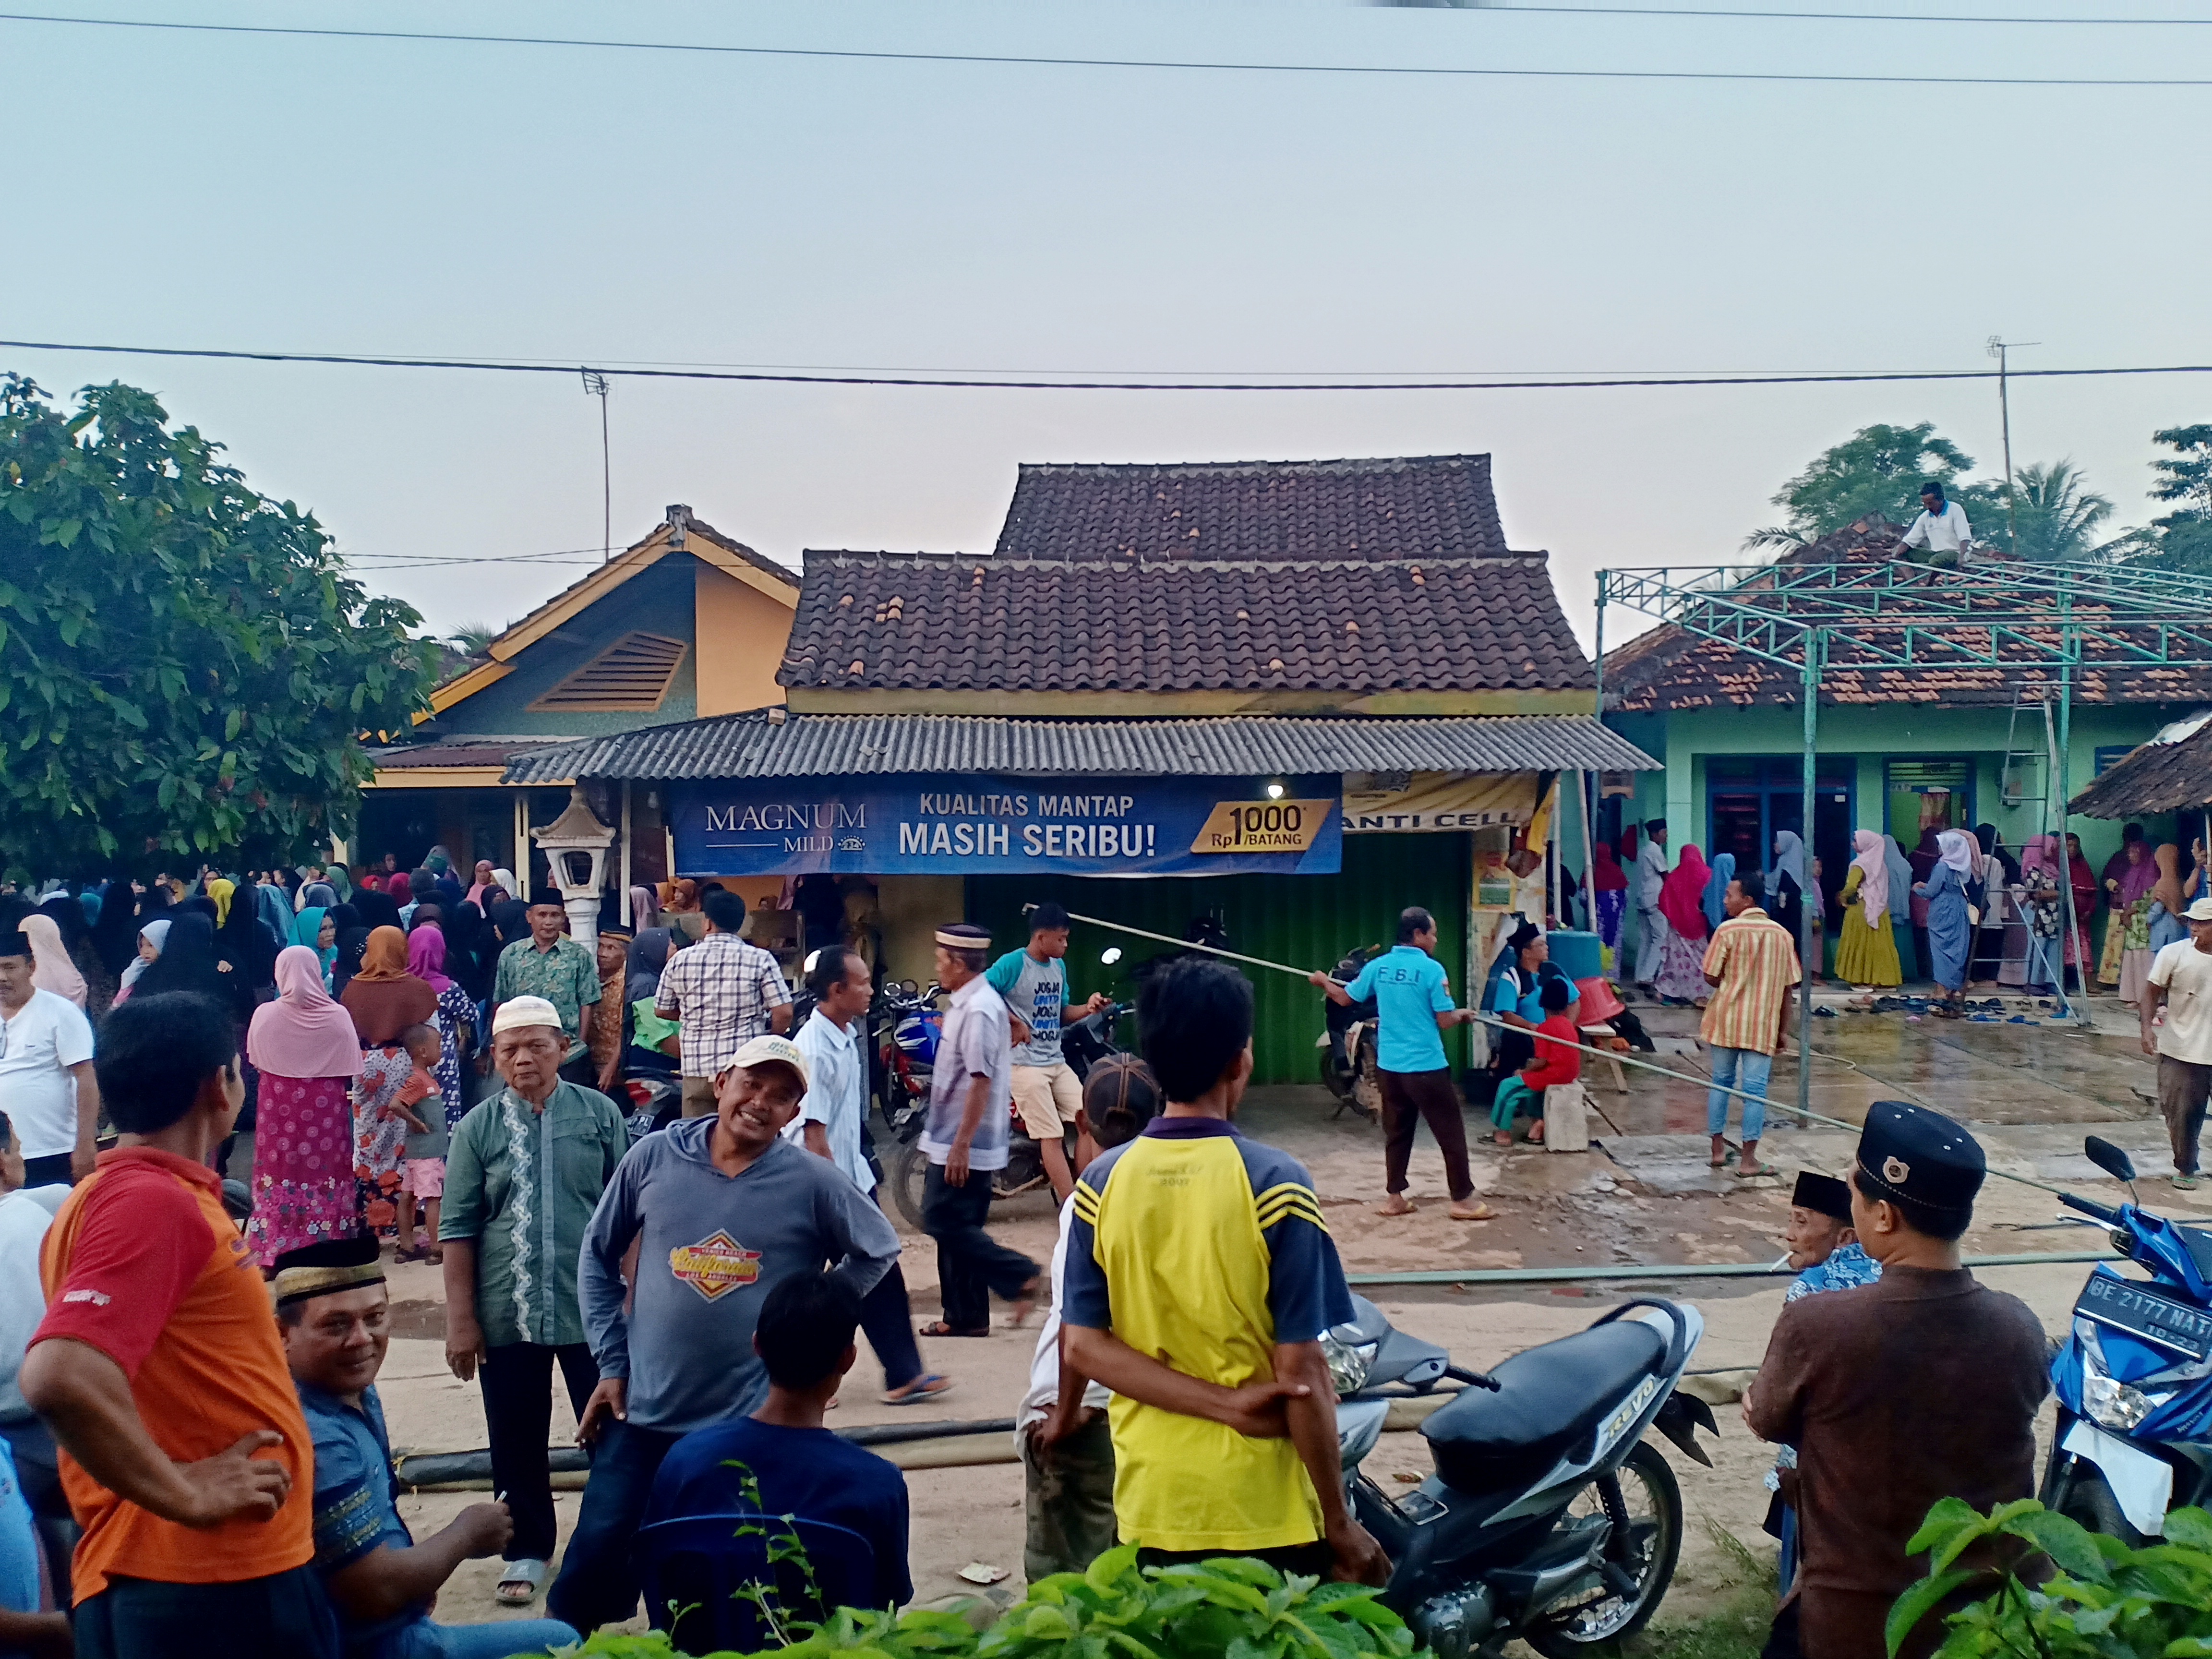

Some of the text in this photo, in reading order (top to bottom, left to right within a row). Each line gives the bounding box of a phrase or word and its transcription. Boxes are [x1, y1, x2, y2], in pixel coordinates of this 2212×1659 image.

[705, 803, 867, 831] MAGNUM
[920, 793, 1134, 817] KUALITAS MANTAP
[1434, 812, 1516, 827] CELL
[783, 836, 834, 853] MILD
[899, 822, 1155, 857] MASIH SERIBU!
[1212, 833, 1232, 848] Rp
[2090, 1280, 2117, 1301] BE
[2117, 1291, 2168, 1320] 2177
